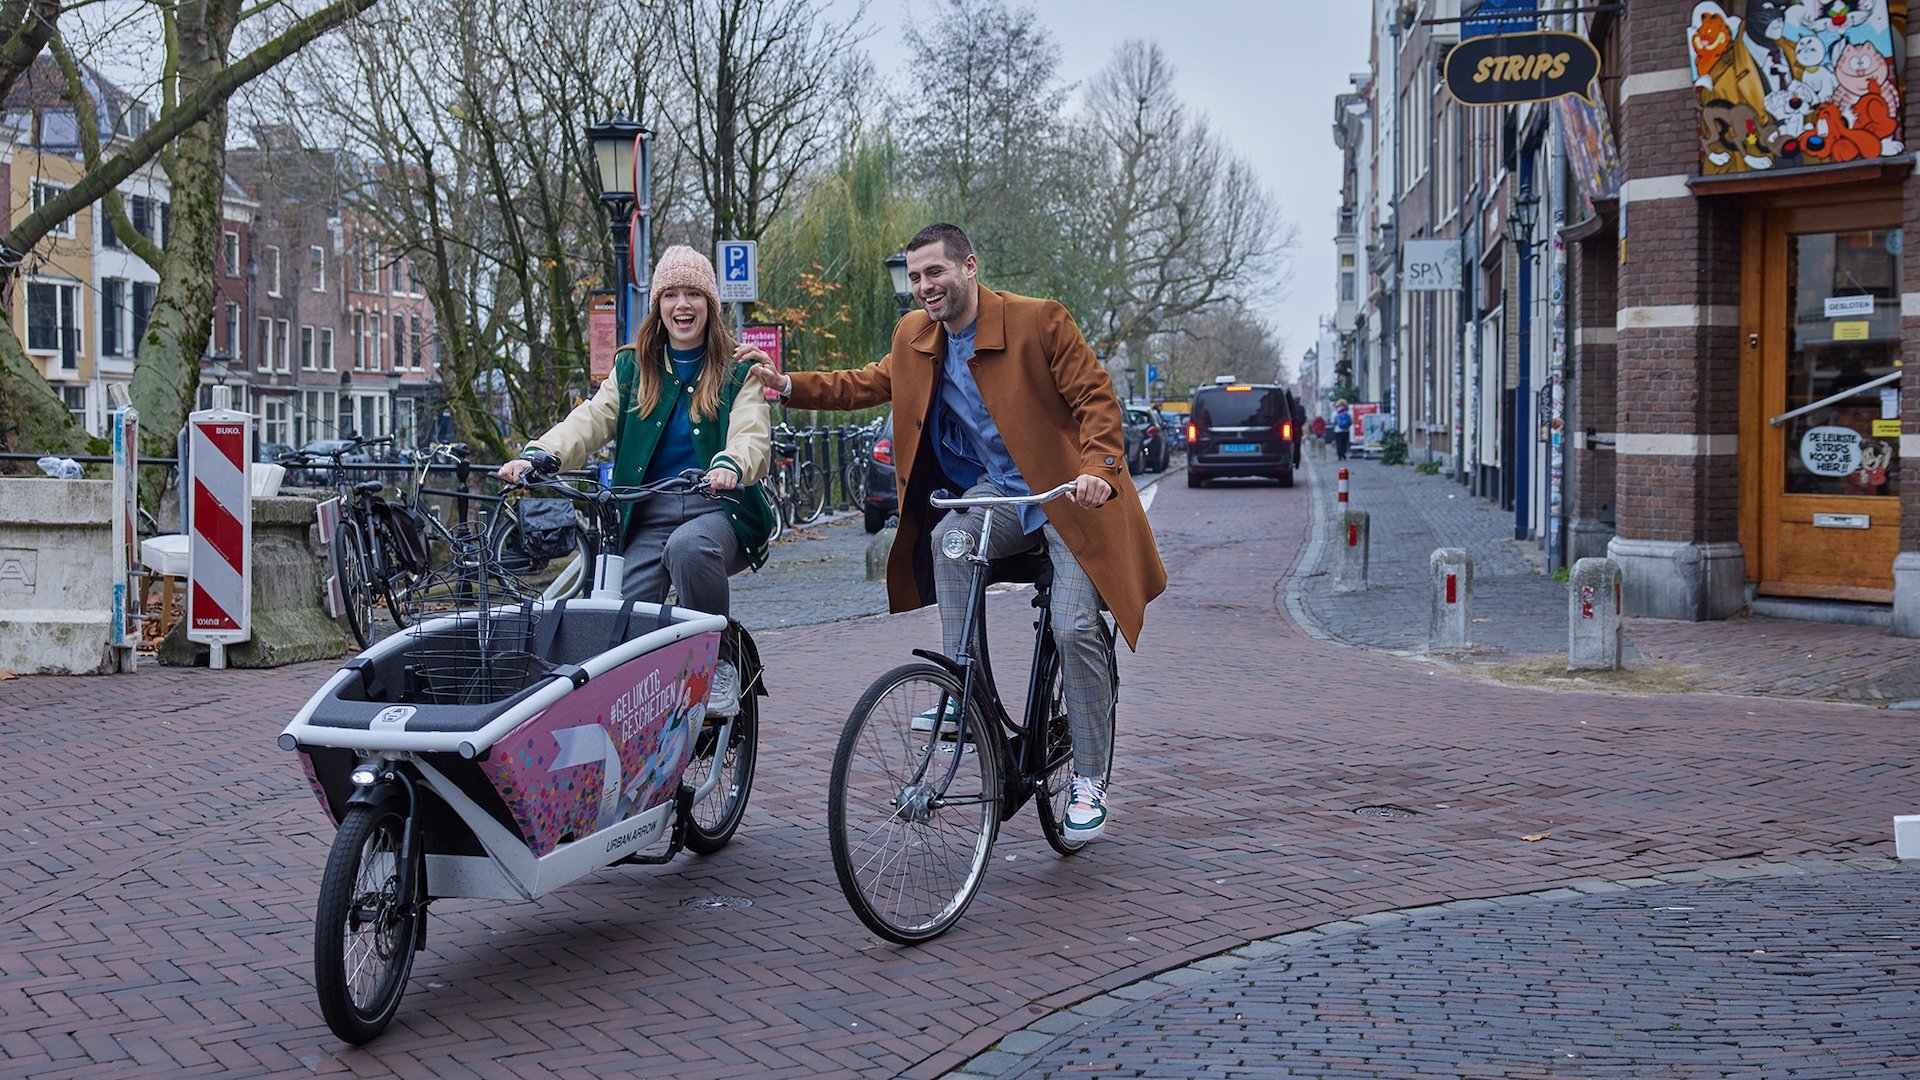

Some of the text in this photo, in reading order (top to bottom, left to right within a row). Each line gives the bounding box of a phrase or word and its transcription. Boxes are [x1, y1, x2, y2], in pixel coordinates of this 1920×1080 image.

[1473, 52, 1570, 83] STRIPS
[730, 247, 744, 267] P
[1410, 262, 1443, 279] SPA
[1829, 302, 1870, 311] GESLOTEN
[1809, 432, 1858, 444] DE LEUKSTE
[1809, 452, 1853, 463] KOOP JE
[1815, 443, 1850, 454] STRIPS
[610, 668, 661, 725] #GELUKKIG
[622, 681, 676, 743] GESCHEIDEN
[606, 819, 658, 852] URBAN ARROW
